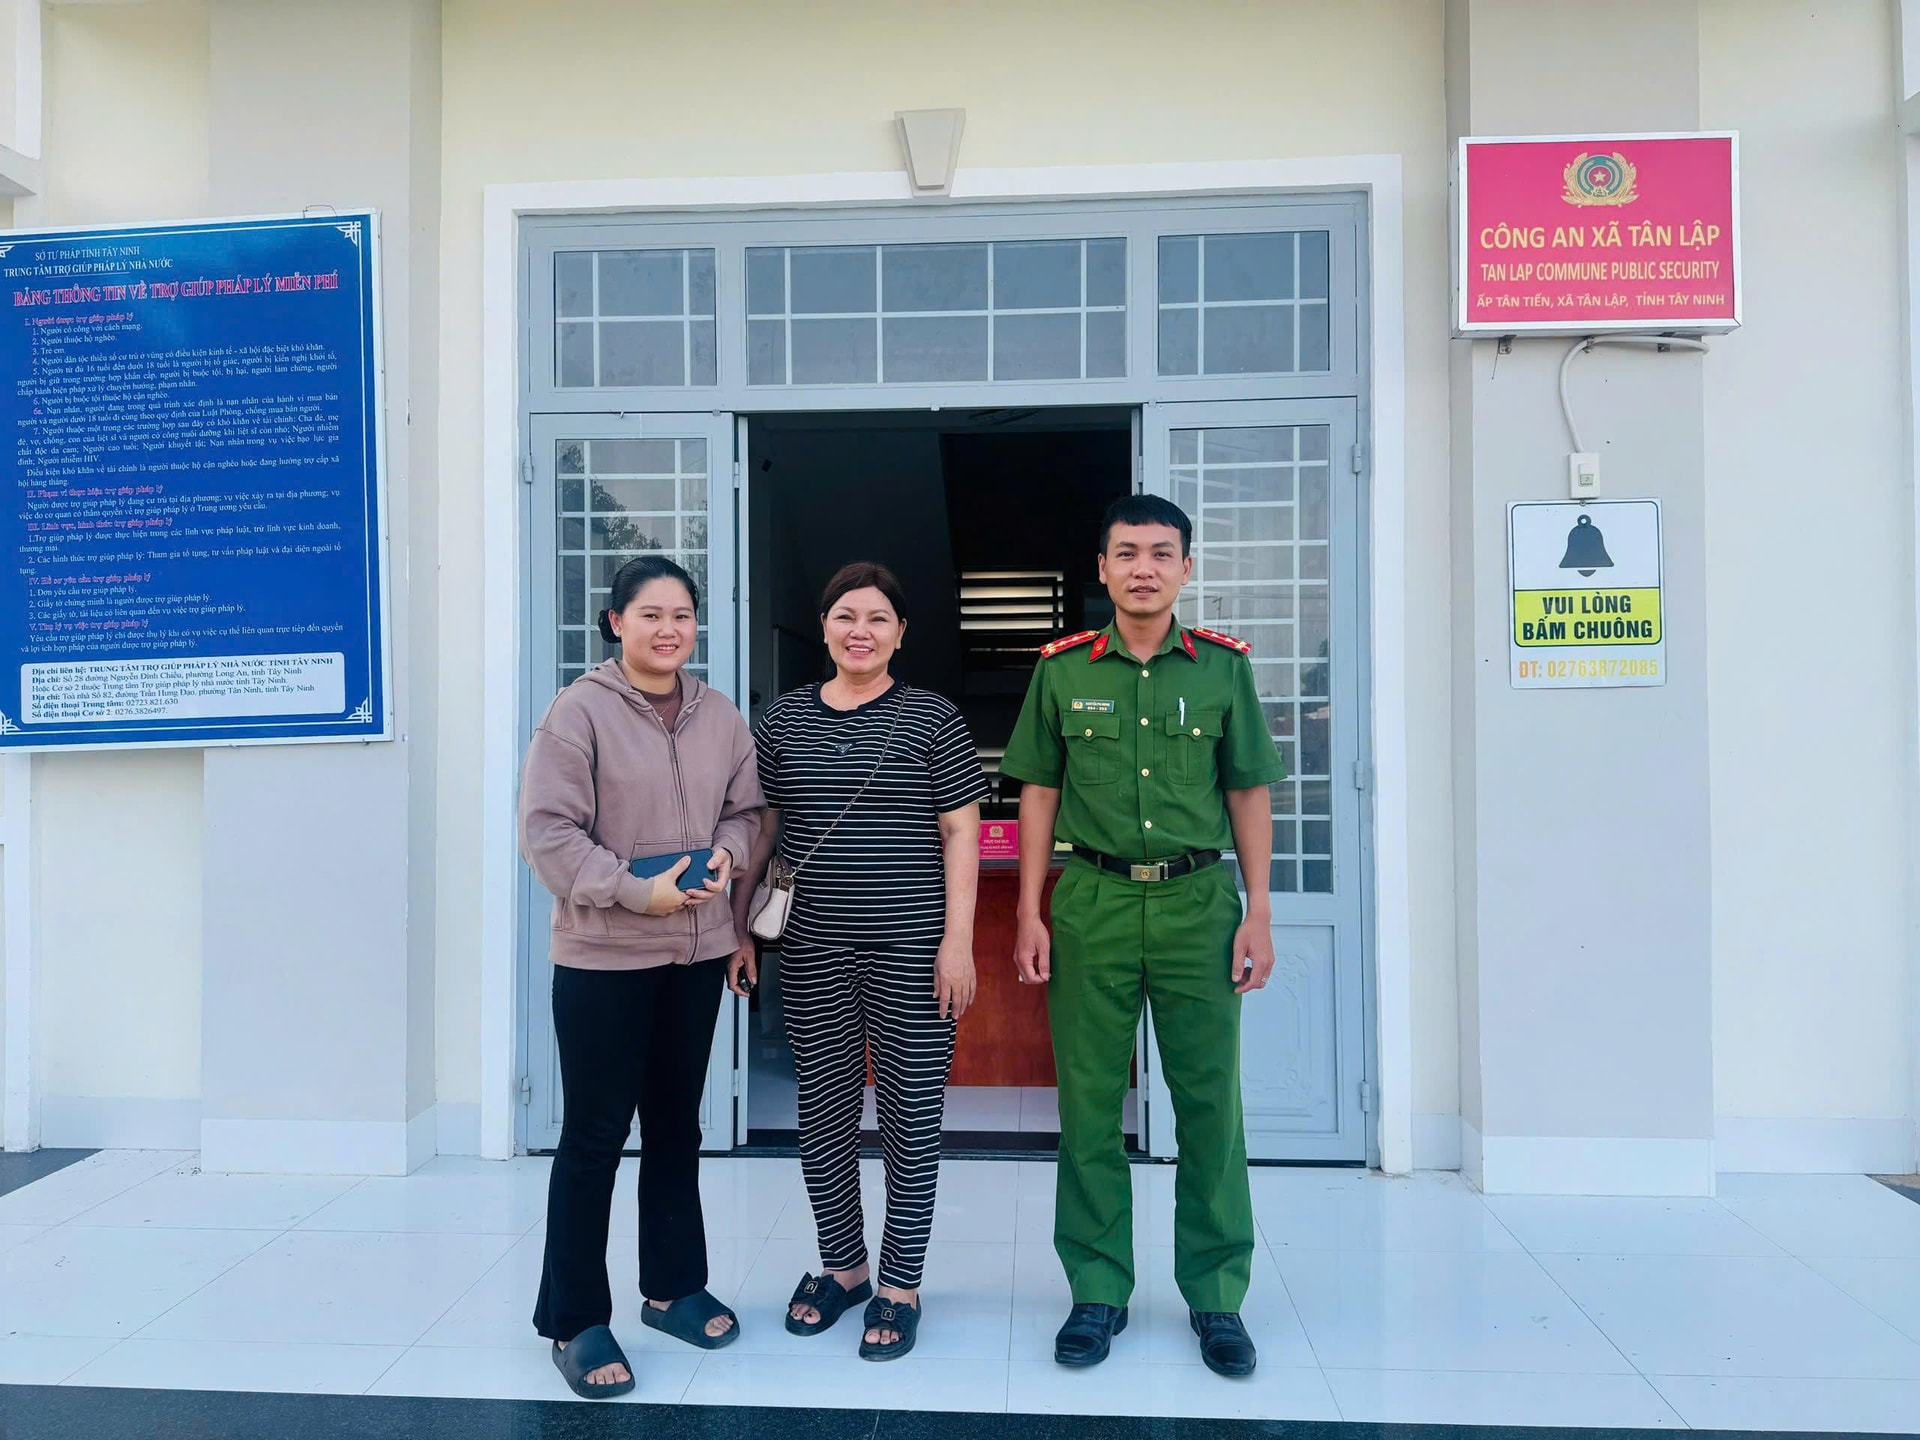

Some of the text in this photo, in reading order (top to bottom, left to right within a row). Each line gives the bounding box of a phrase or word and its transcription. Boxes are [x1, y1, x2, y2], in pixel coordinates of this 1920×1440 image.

[1481, 220, 1720, 251] CÔNG AN XÃ TÂN LẬP
[4, 256, 172, 276] TRUNG TÂM TRỢ GIÚP PHÁP LÝ NHÀ NƯỚC
[1482, 261, 1719, 282] TAN LAP COMMUNE PUBLIC SECURITY
[13, 285, 51, 306] BẢNG
[52, 282, 100, 304] THÔNG
[102, 284, 126, 301] TIN
[128, 279, 147, 299] VỀ
[149, 281, 178, 302] TRỢ
[180, 276, 214, 296] GIÚP
[215, 274, 252, 294] PHÁP
[253, 272, 272, 293] LÝ
[313, 269, 338, 290] PHÍ
[1477, 292, 1725, 309] ẤP TÂN TIẾN, XÃ TÂN LẬP, TỈNH TÂY NINH
[1542, 592, 1632, 615] VUI LÒNG
[1523, 617, 1653, 640] BẤM CHUÔNG
[1519, 659, 1658, 678] ĐT: 02763872085
